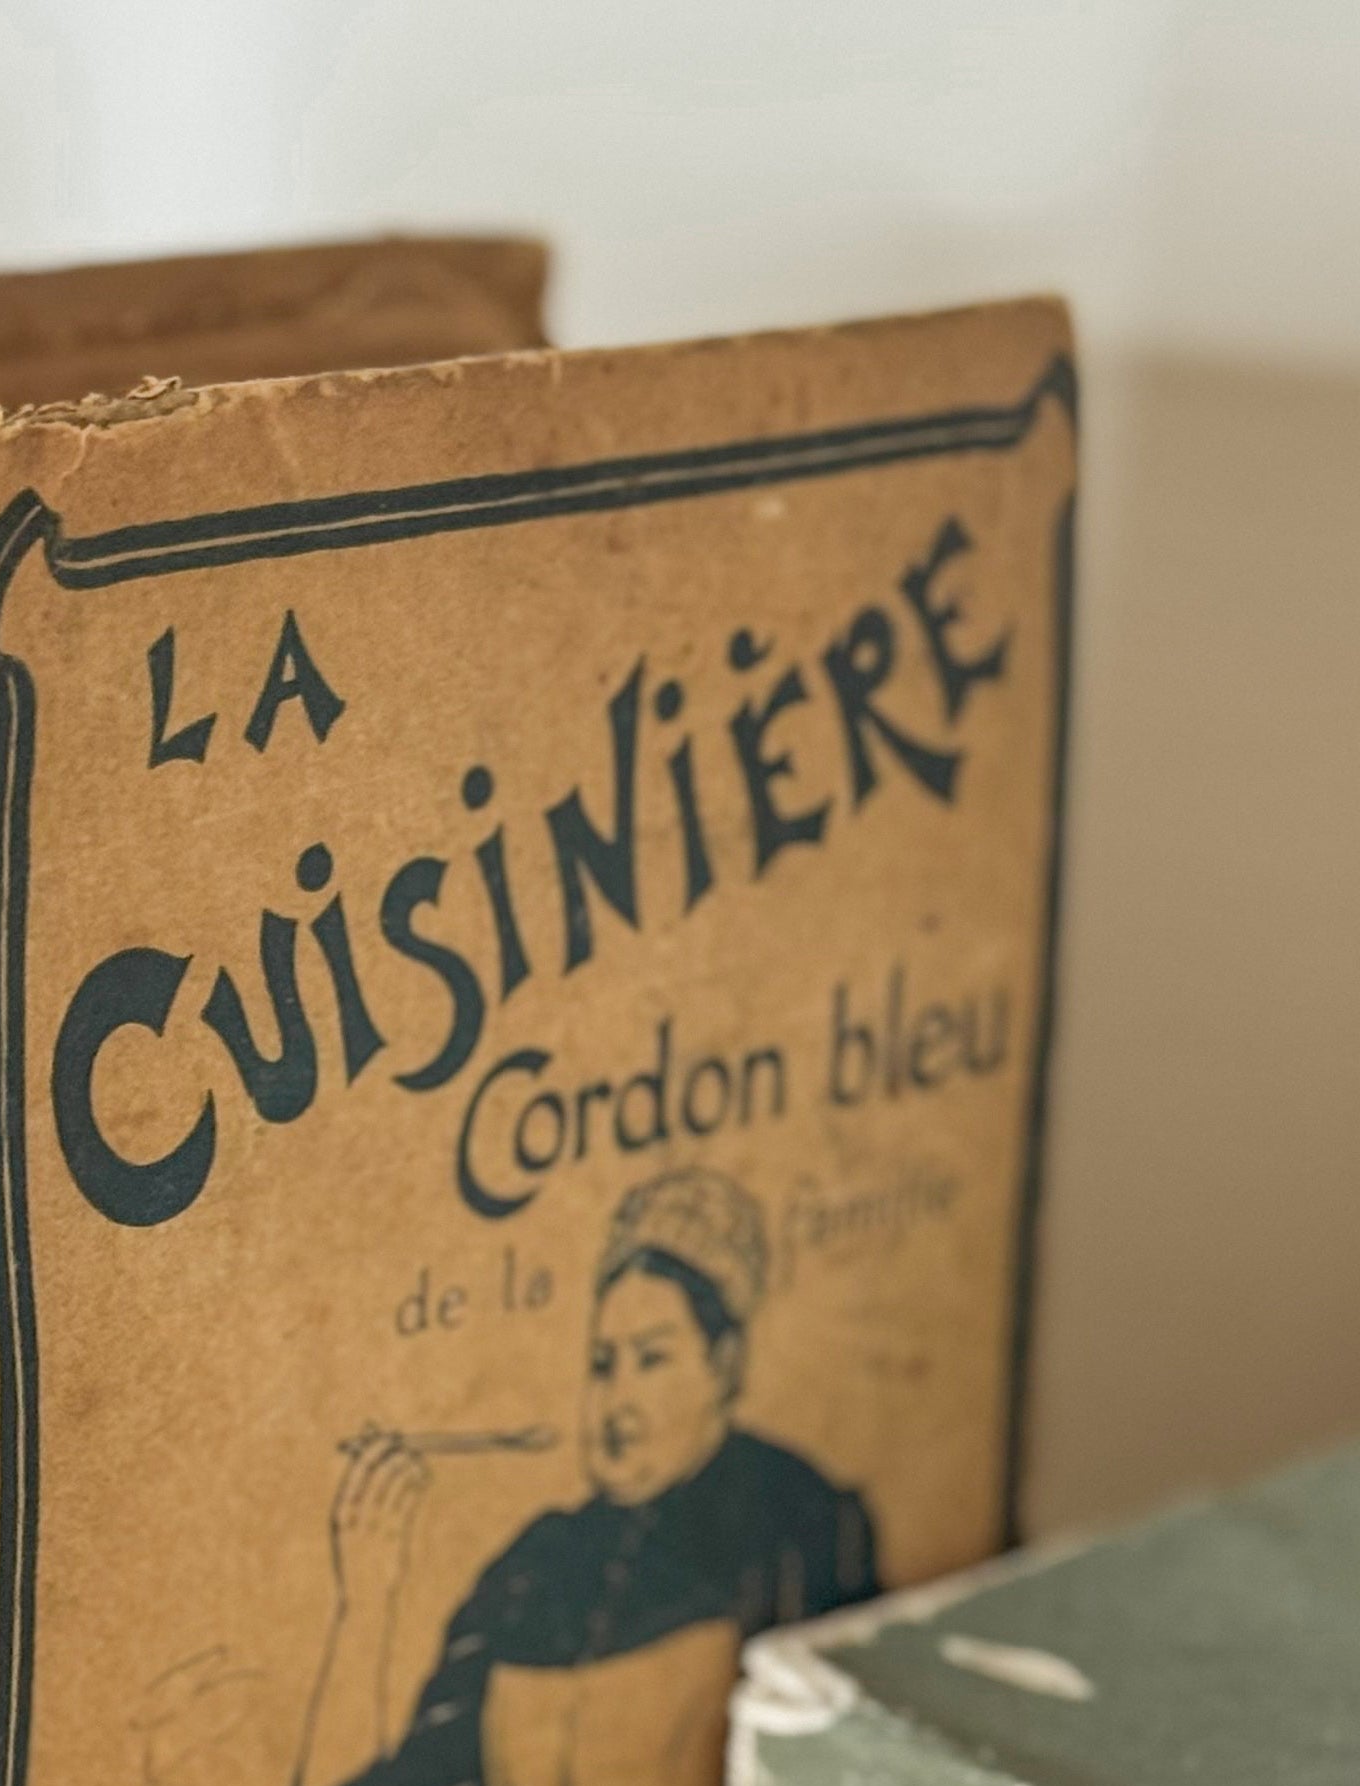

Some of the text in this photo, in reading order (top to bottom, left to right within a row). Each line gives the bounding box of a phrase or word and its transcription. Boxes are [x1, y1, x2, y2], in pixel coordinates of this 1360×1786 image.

[146, 609, 346, 770] LA
[456, 958, 1012, 1221] Cordon bleu
[395, 1266, 468, 1338] de
[501, 1243, 553, 1316] la
